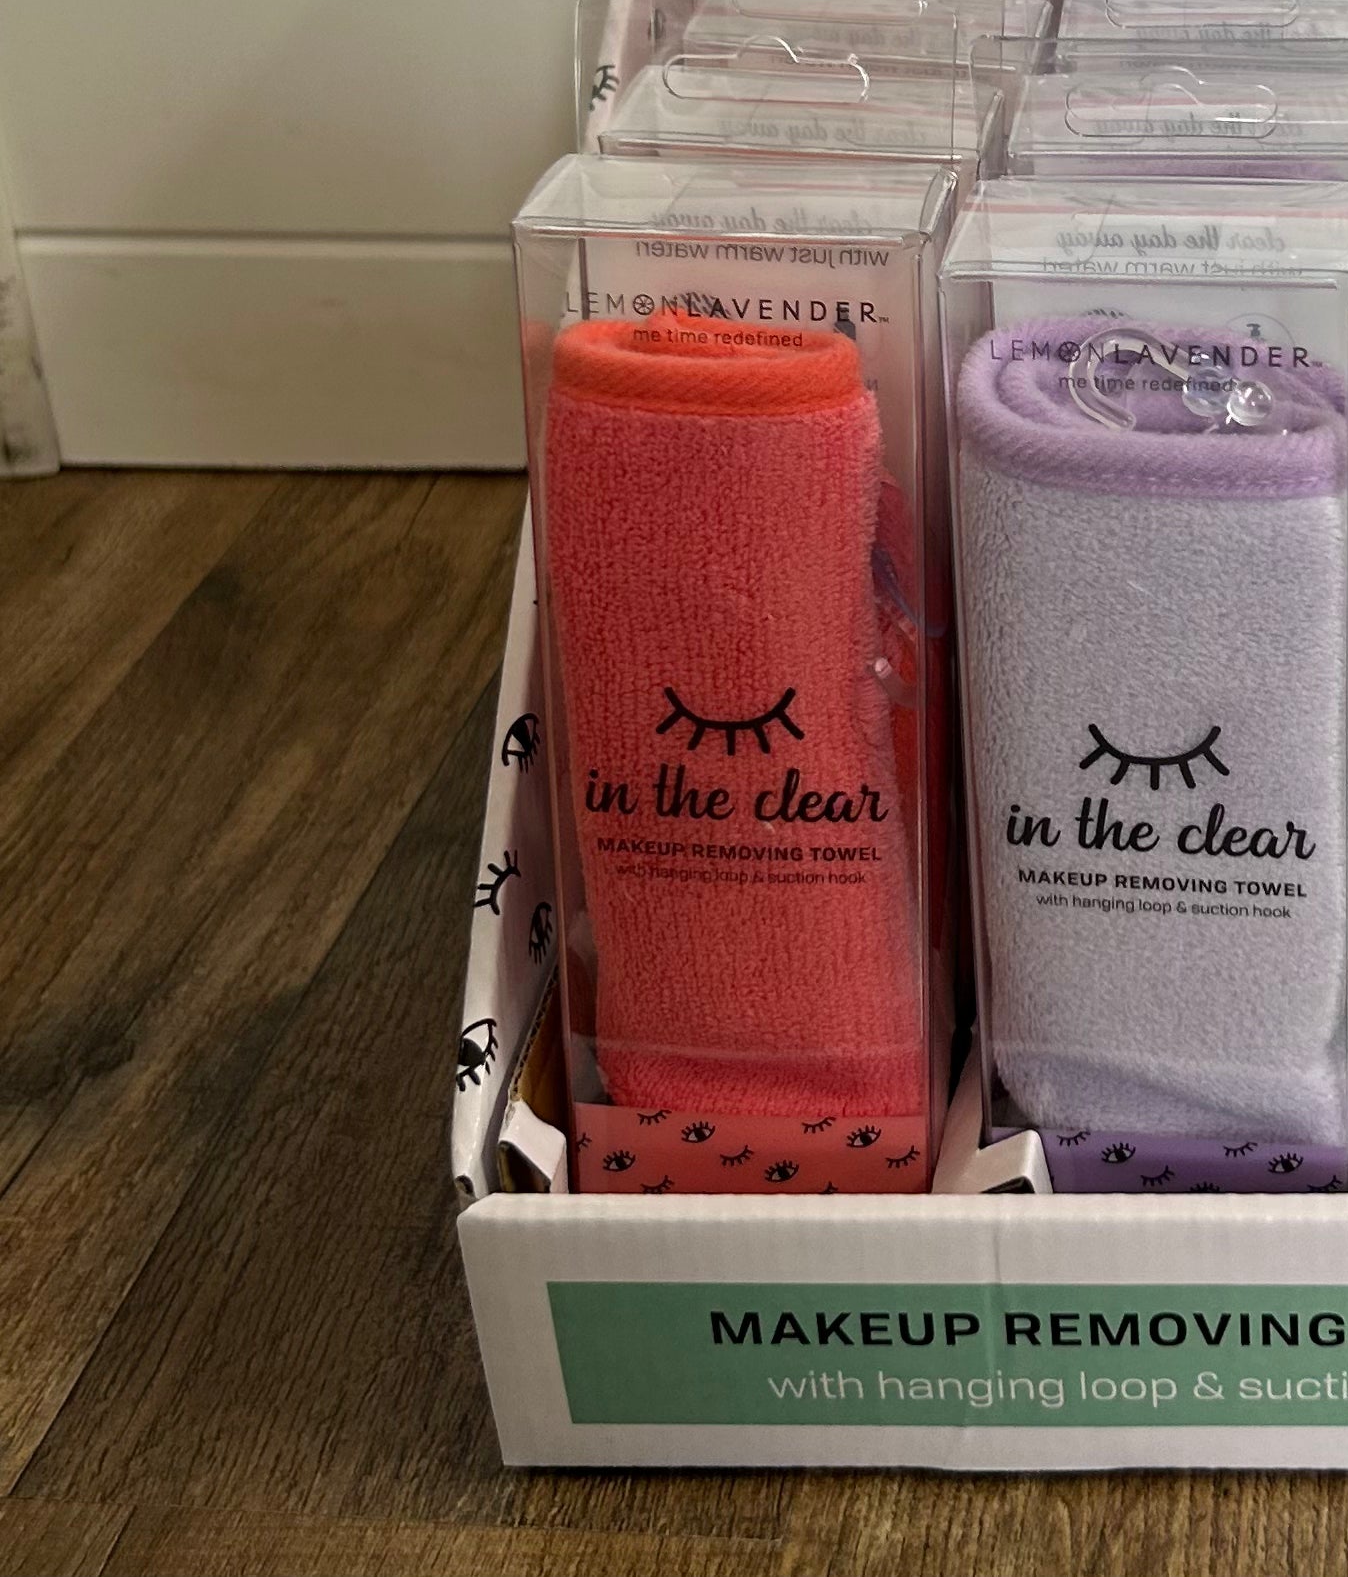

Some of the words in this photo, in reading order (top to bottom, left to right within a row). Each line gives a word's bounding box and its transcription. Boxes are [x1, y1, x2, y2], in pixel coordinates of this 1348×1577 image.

[633, 331, 661, 343] me
[668, 328, 707, 345] time
[714, 330, 803, 348] redefined
[1059, 376, 1087, 389] me
[1094, 376, 1135, 392] time
[585, 769, 639, 815] in
[655, 763, 734, 820] the
[755, 768, 888, 823] clear
[1006, 804, 1061, 846] in
[1076, 797, 1160, 852] the
[1178, 803, 1316, 860] clear
[597, 837, 684, 856] MAKEUP
[692, 843, 802, 862] REMOVING
[810, 846, 881, 861] TOWEL
[1019, 870, 1107, 888] MAKEUP
[1115, 875, 1227, 894] REMOVING
[1234, 881, 1307, 897] TOWEL
[1037, 894, 1068, 907] with
[1072, 895, 1134, 913] hanging
[1138, 899, 1172, 915] loop
[1176, 901, 1186, 913] &
[1192, 903, 1248, 917] suction
[1253, 905, 1291, 919] hook
[710, 1311, 981, 1347] MAKEUP
[1004, 1311, 1347, 1347] REMOVING
[768, 1370, 865, 1402] with
[877, 1370, 1064, 1409] hanging
[1079, 1370, 1178, 1409] loop
[1193, 1371, 1225, 1402] &
